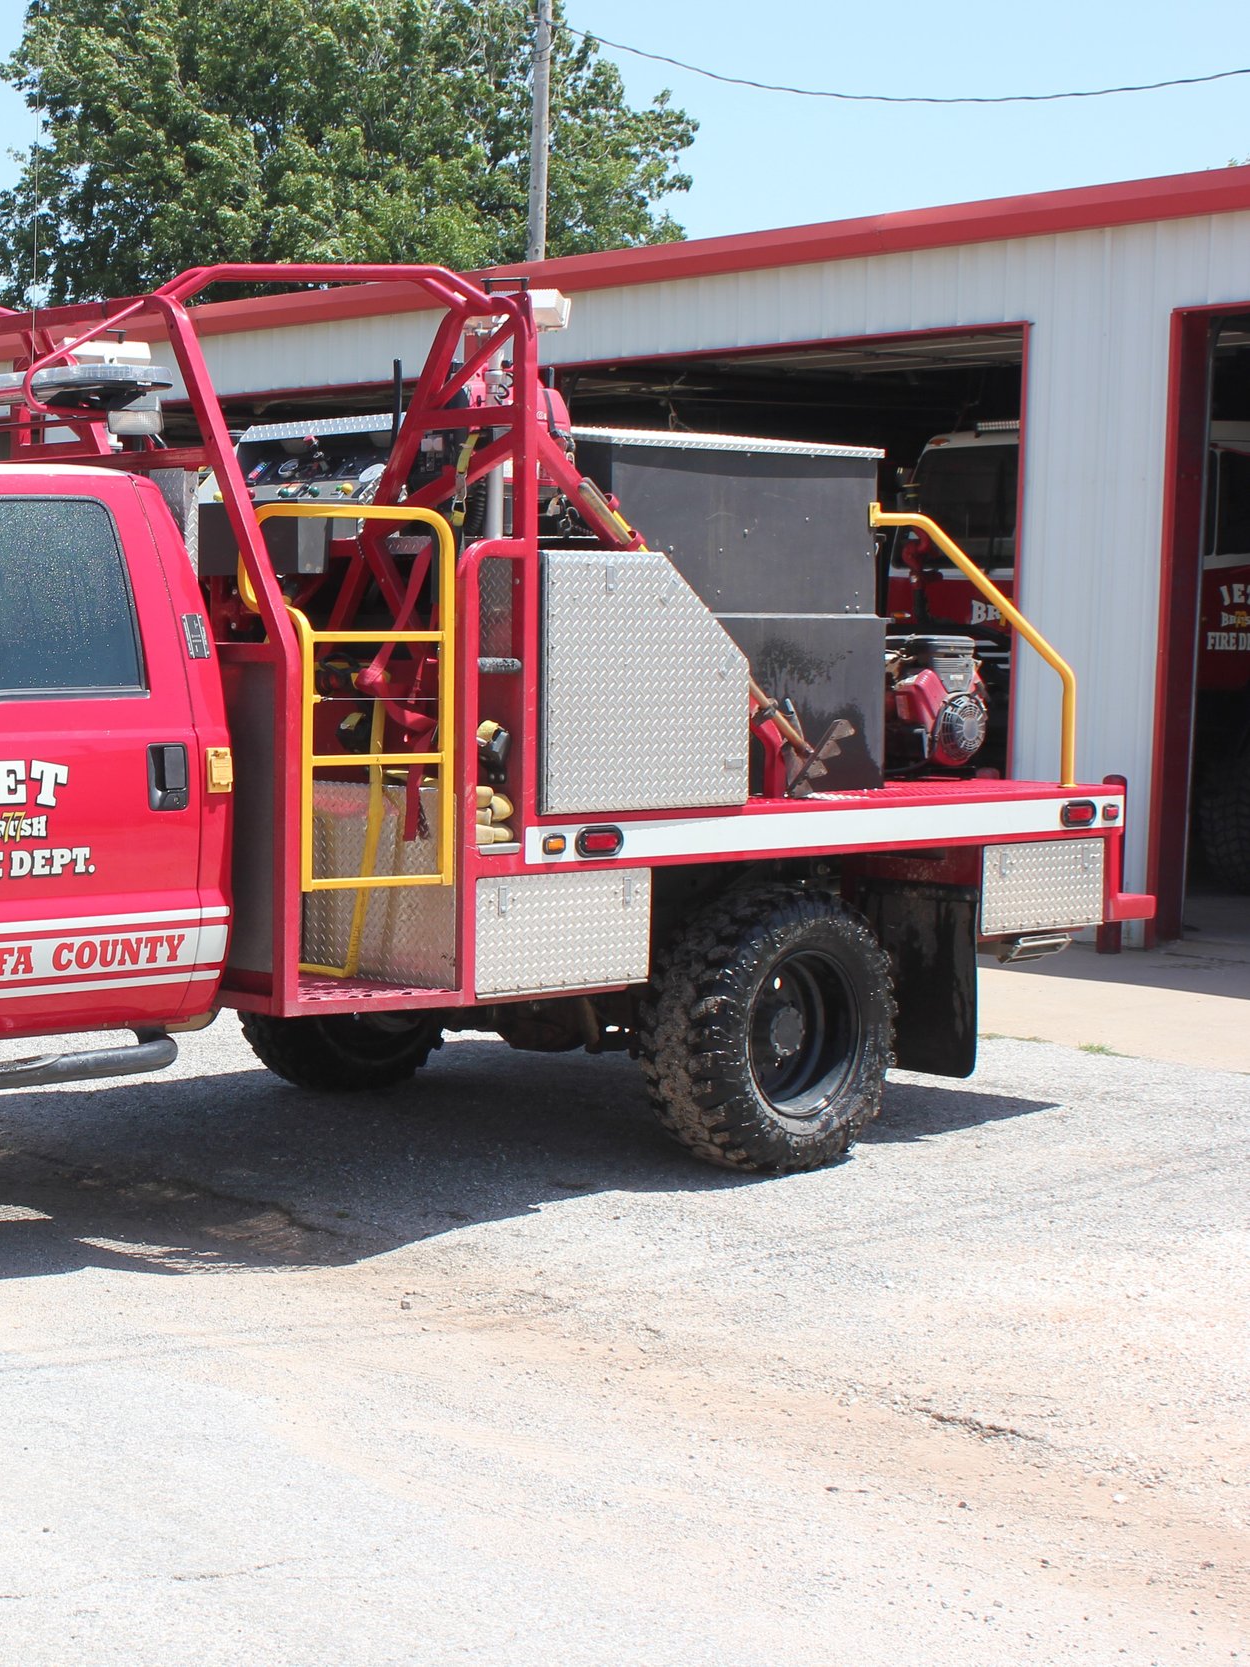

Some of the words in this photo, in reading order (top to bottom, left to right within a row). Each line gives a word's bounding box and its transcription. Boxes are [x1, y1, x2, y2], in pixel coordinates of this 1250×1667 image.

[1207, 631, 1237, 650] FIRE
[1, 811, 26, 843] 77
[10, 846, 96, 877] DEPT.
[51, 933, 186, 972] COUNTY
